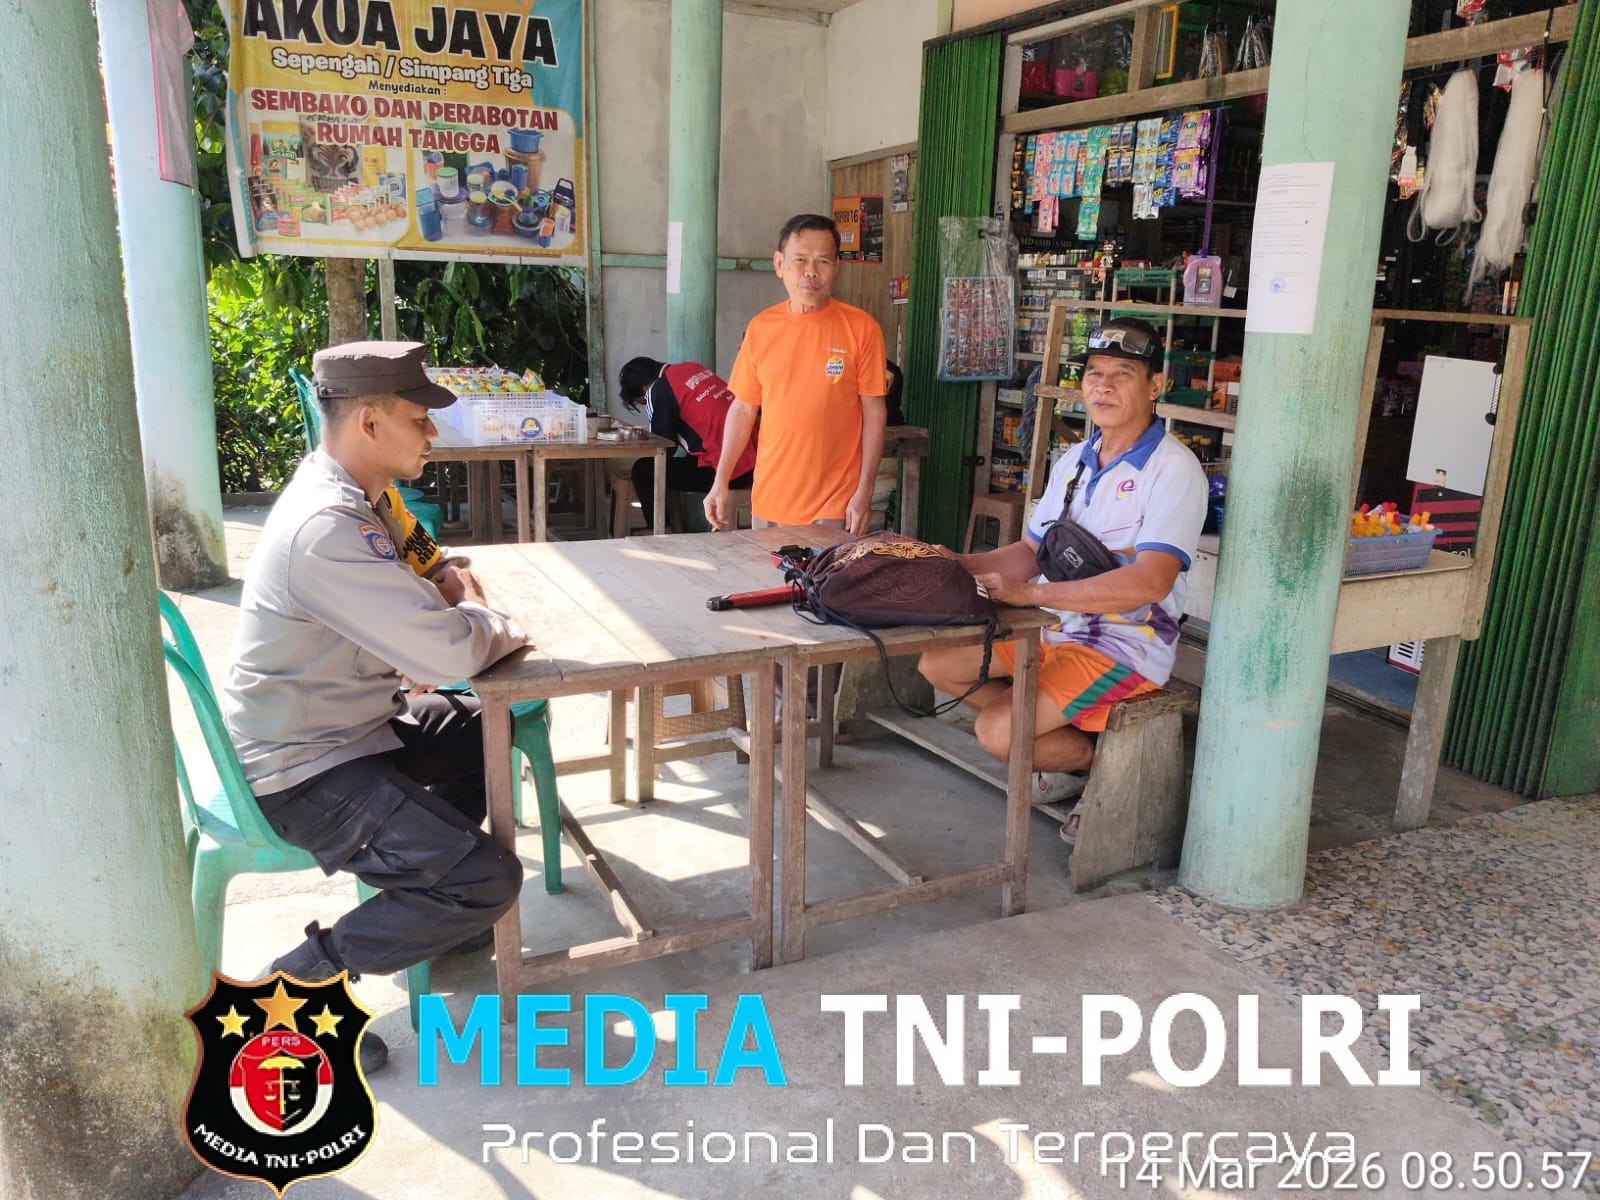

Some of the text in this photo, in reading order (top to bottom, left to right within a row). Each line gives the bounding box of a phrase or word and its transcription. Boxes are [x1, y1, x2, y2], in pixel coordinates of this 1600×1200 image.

[243, 0, 558, 67] AKUA JAYA
[271, 47, 381, 79] Sepengah
[399, 57, 490, 90] Simpang
[491, 65, 533, 93] Tiga
[368, 80, 441, 95] Menyediakan
[251, 89, 558, 131] SEMBAKO DAN PERABOTAN
[317, 122, 501, 154] RUMAH TANGGA
